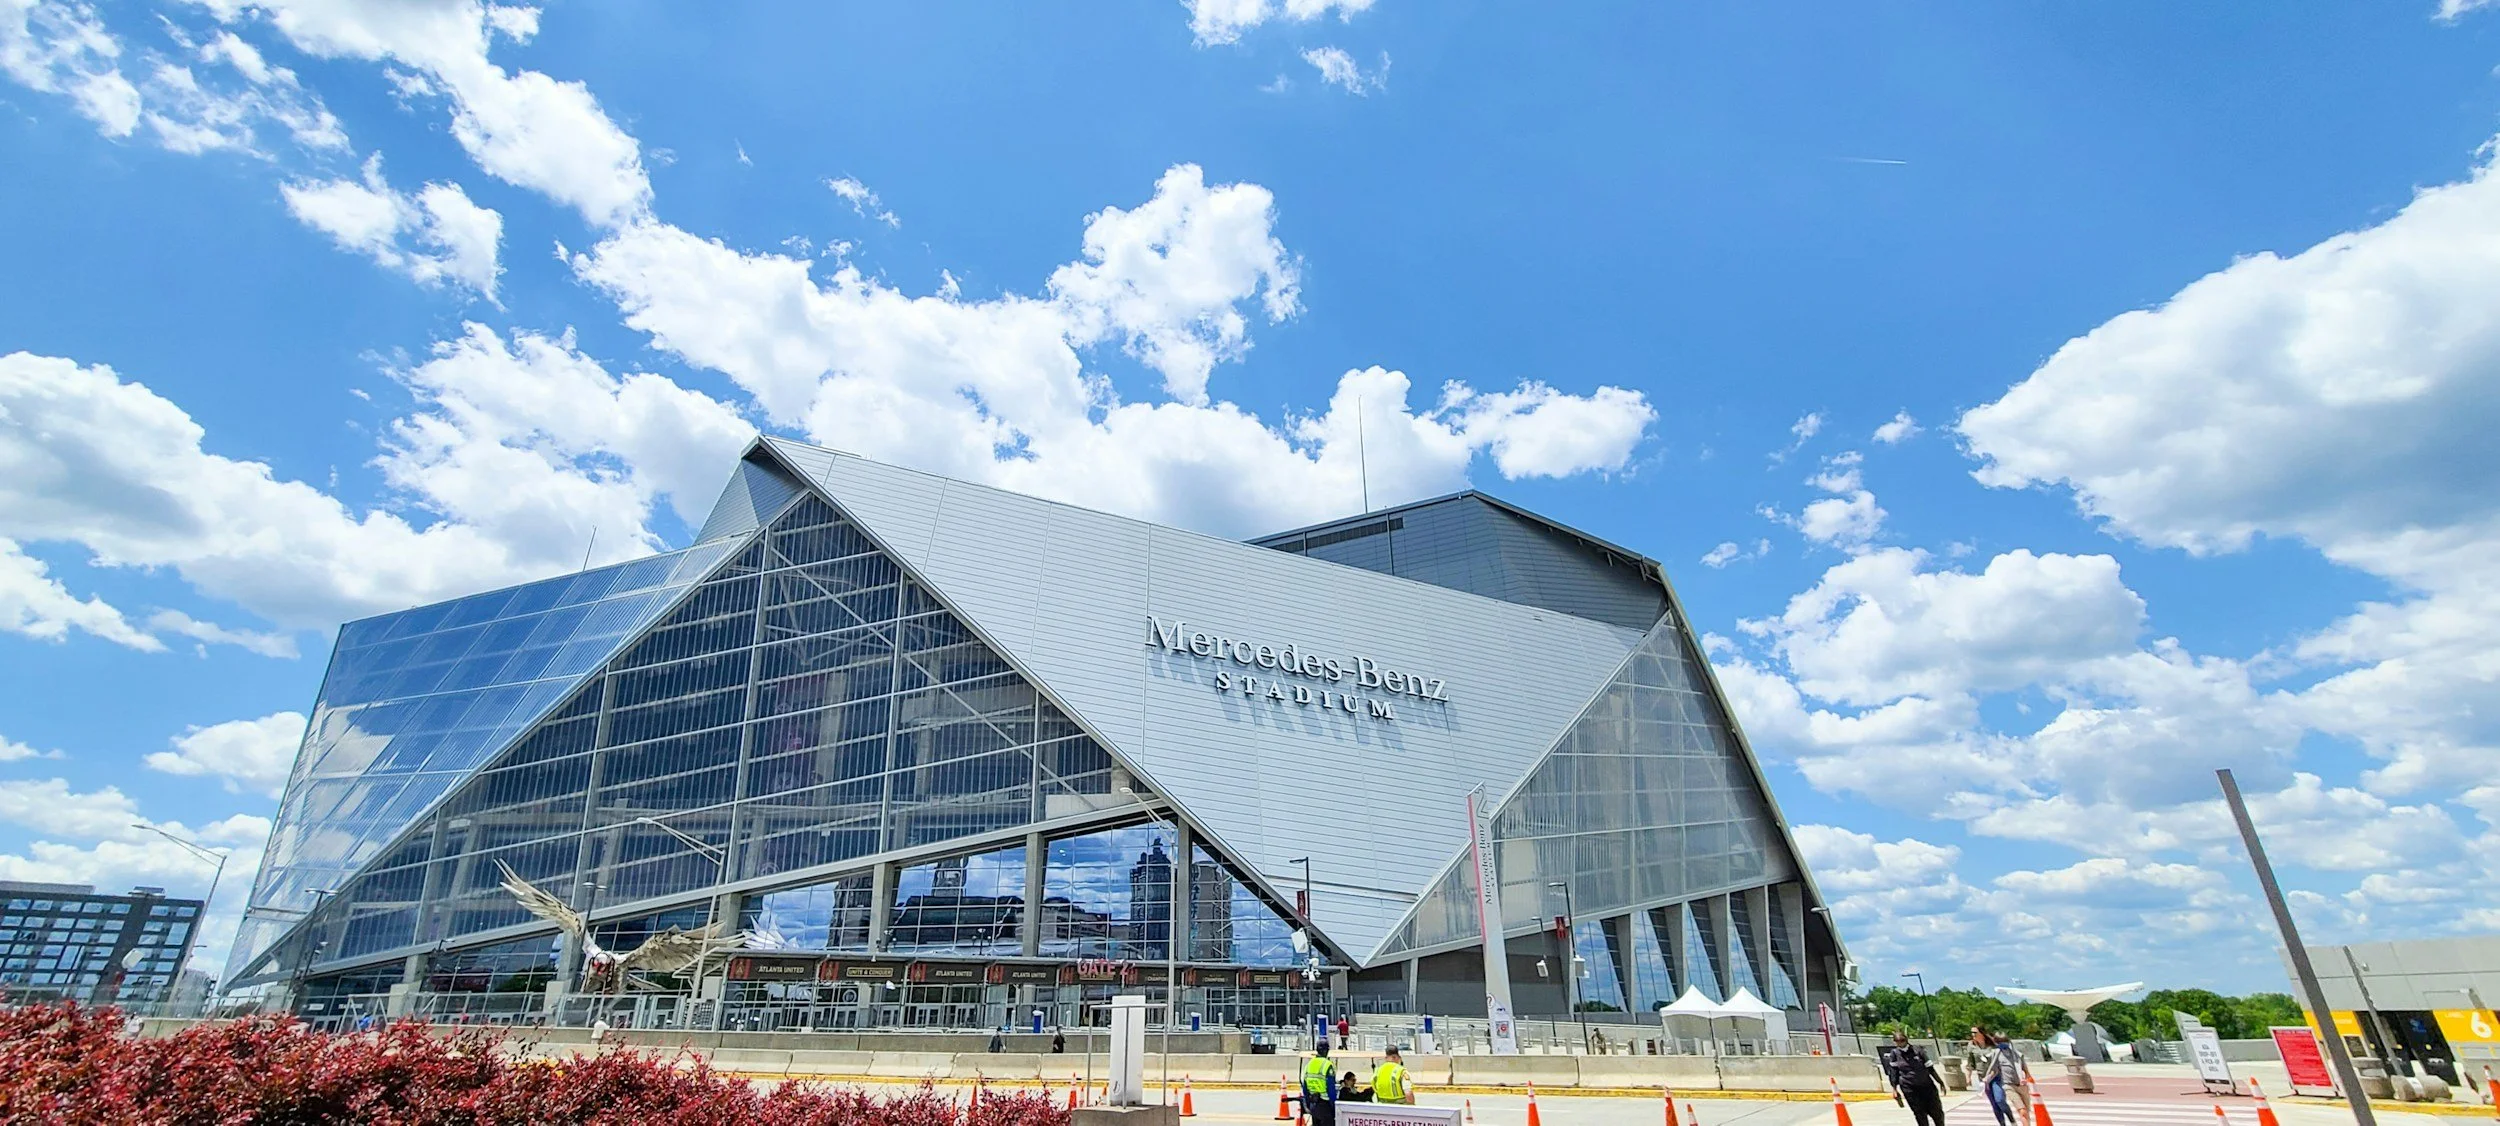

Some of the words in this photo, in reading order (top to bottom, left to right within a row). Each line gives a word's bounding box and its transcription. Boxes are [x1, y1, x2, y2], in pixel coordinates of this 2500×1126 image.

[1145, 614, 1449, 702] Mercedes-Benz
[1216, 671, 1395, 720] STADIUM
[758, 965, 782, 973] ATLANTA
[783, 966, 805, 974] UNITED
[1077, 958, 1116, 977] GATE
[1120, 960, 1129, 976] 2
[2471, 1011, 2492, 1039] 6
